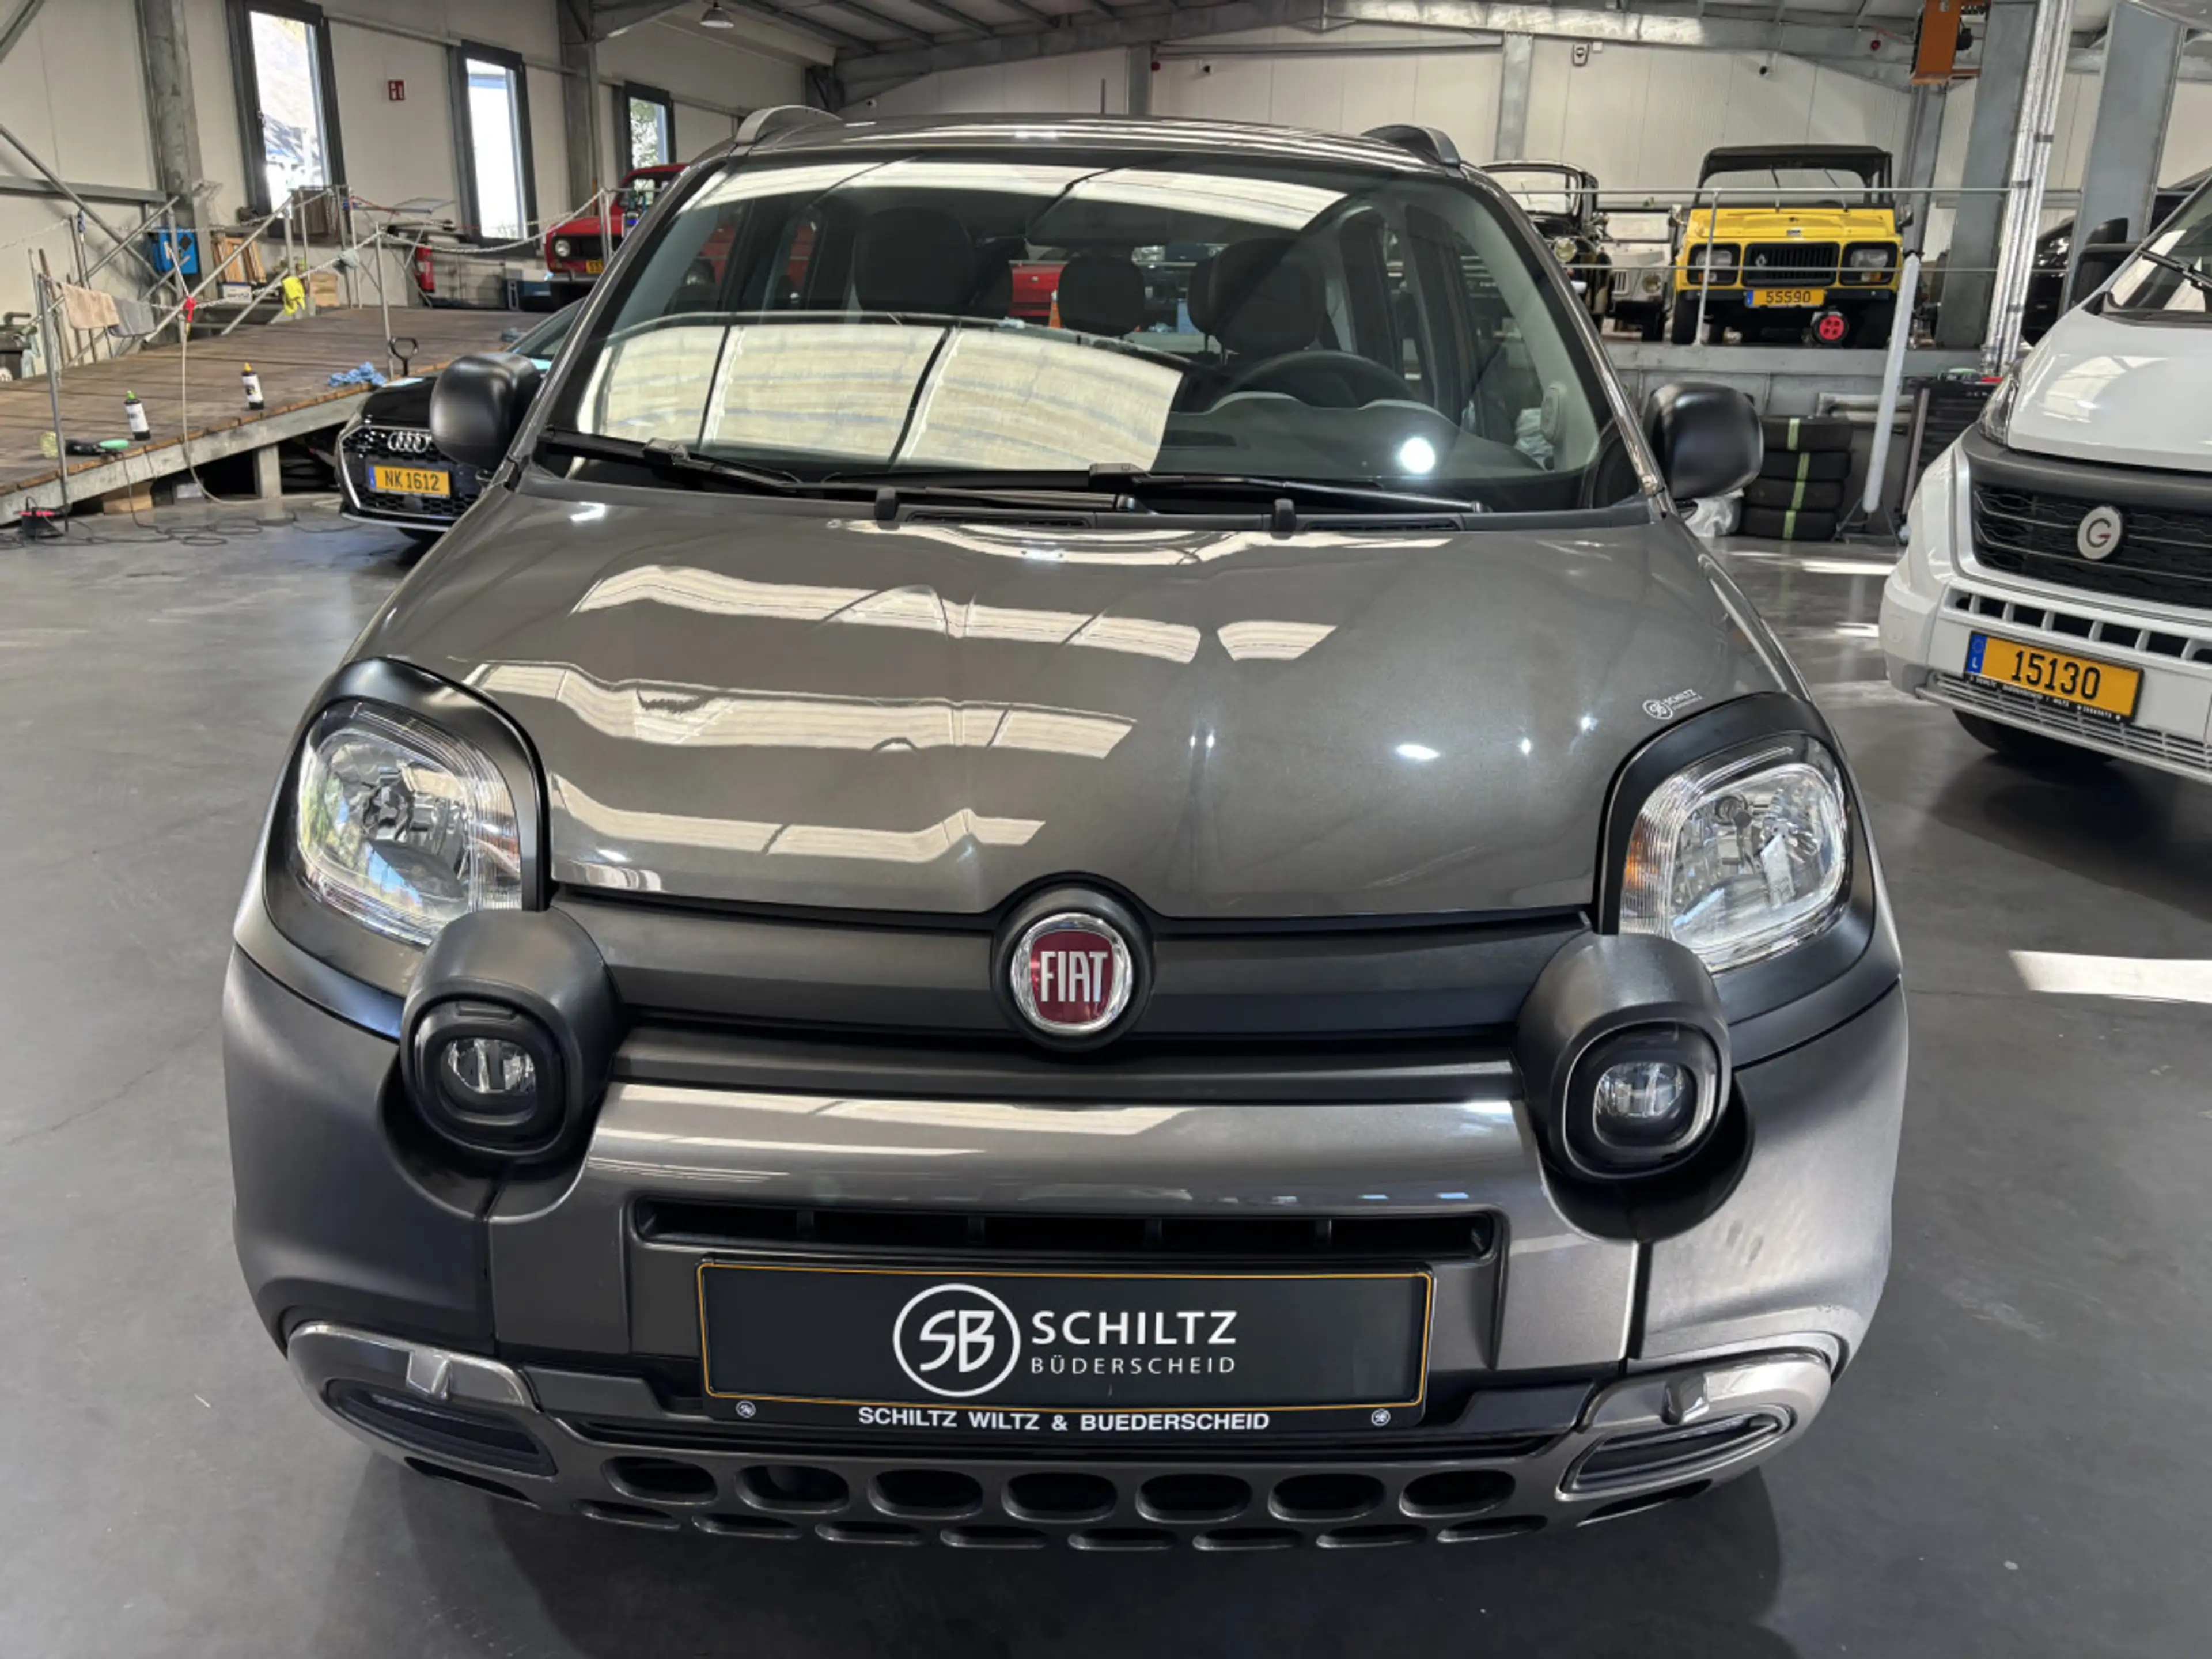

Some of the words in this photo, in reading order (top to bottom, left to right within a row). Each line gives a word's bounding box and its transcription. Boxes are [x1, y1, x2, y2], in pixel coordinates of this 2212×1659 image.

[1766, 290, 1811, 304] 55590
[384, 469, 403, 487] NK
[404, 472, 440, 491] 1612
[2011, 650, 2101, 700] 15130
[1040, 951, 1108, 1002] FIAT
[919, 1310, 995, 1373] SB
[1032, 1310, 1237, 1345] SCHILTZ
[1031, 1355, 1236, 1374] BÜDERSCHEID
[858, 1407, 957, 1427] SCHILTZ
[968, 1411, 1040, 1430] WILTZ
[1051, 1414, 1068, 1431] &
[1081, 1413, 1270, 1431] BUEDERSCHEID
